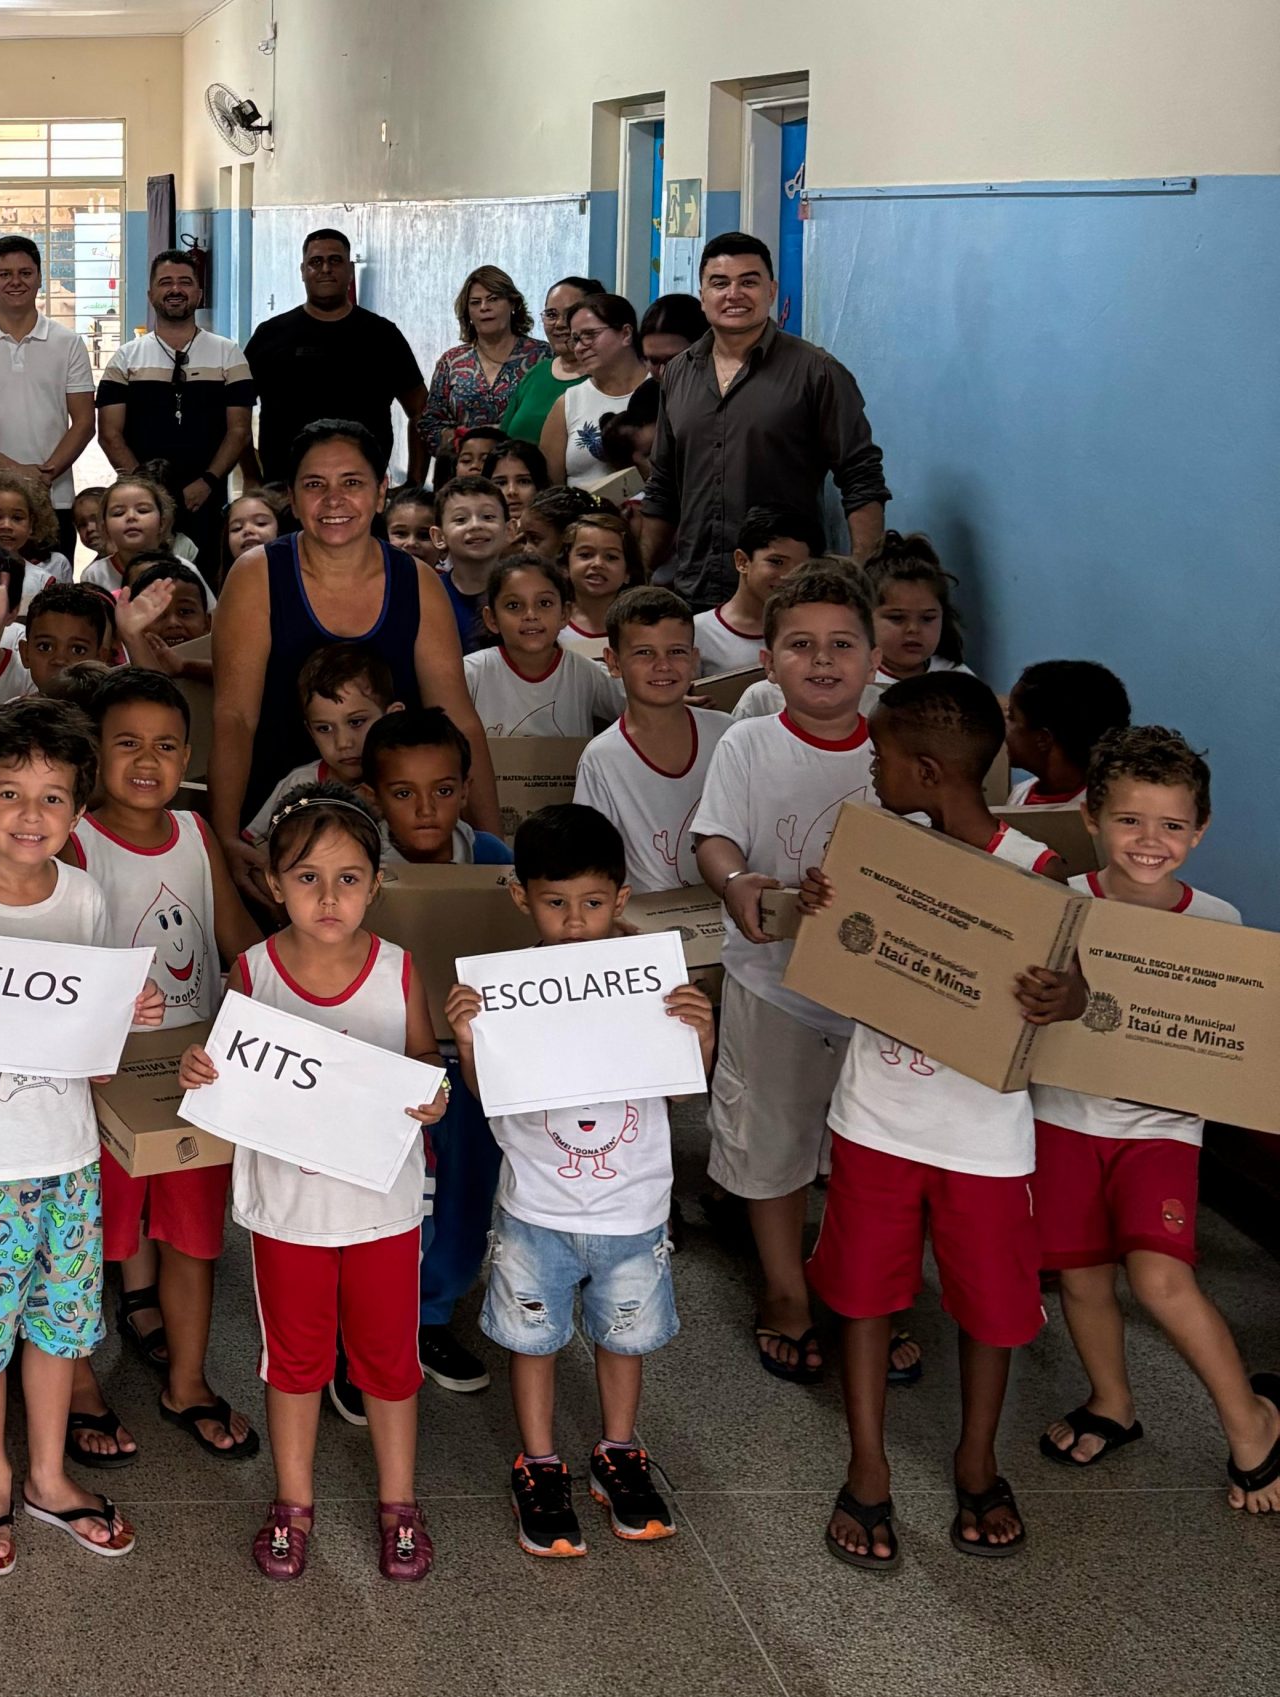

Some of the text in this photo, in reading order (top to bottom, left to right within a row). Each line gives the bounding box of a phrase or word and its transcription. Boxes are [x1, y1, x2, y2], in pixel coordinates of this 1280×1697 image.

[860, 866, 873, 877] KIT
[873, 871, 911, 894] MATERIAL
[877, 941, 910, 966] Itaú
[911, 959, 932, 977] de
[934, 967, 982, 1001] Minas
[883, 930, 979, 980] Prefeitura Municipal
[1089, 947, 1265, 989] KIT MATERIAL ESCOLAR ENSINO INFANTIL
[481, 965, 662, 1012] ESCOLARES
[1133, 965, 1170, 979] ALUNOS
[1171, 972, 1184, 981] DE
[1192, 976, 1217, 988] ANOS
[1127, 1015, 1245, 1052] Itaú de Minas
[1130, 1003, 1236, 1033] Prefeitura Municipal
[226, 1029, 322, 1090] KITS
[552, 1131, 572, 1150] CEMEI
